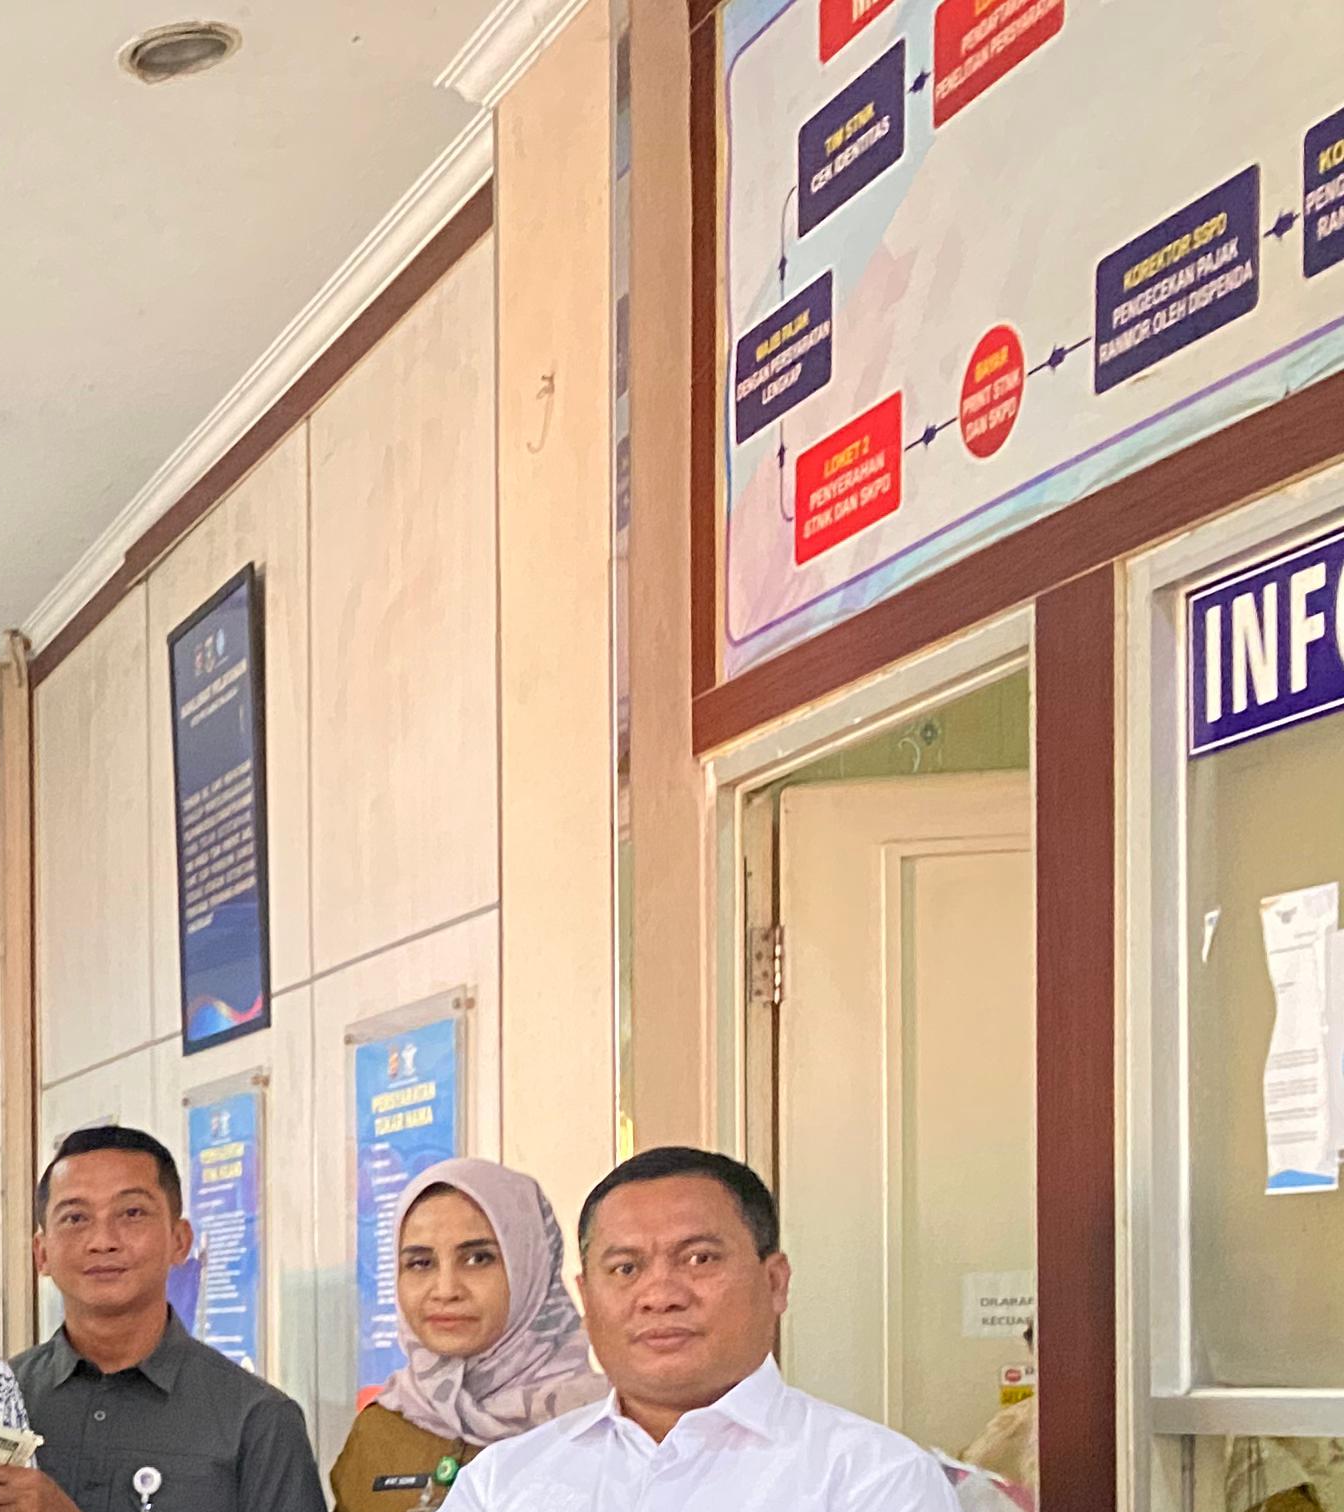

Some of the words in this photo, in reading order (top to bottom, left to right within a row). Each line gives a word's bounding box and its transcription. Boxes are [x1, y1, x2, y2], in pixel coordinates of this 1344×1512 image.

[811, 161, 835, 195] CEK
[833, 114, 891, 175] IDENTITAS
[1112, 260, 1196, 330] PENGECEKAN
[1195, 235, 1239, 281] PAJAK
[1123, 232, 1192, 292] KOREKTOR
[1151, 295, 1188, 336] OLEH
[1187, 258, 1253, 315] DISPENDA
[761, 361, 803, 406] LENGKAP
[965, 413, 989, 444] DAN
[809, 448, 886, 514] PENYERAHAN
[823, 438, 862, 480] LOKET
[833, 493, 859, 522] DAN
[859, 471, 892, 508] SKPD
